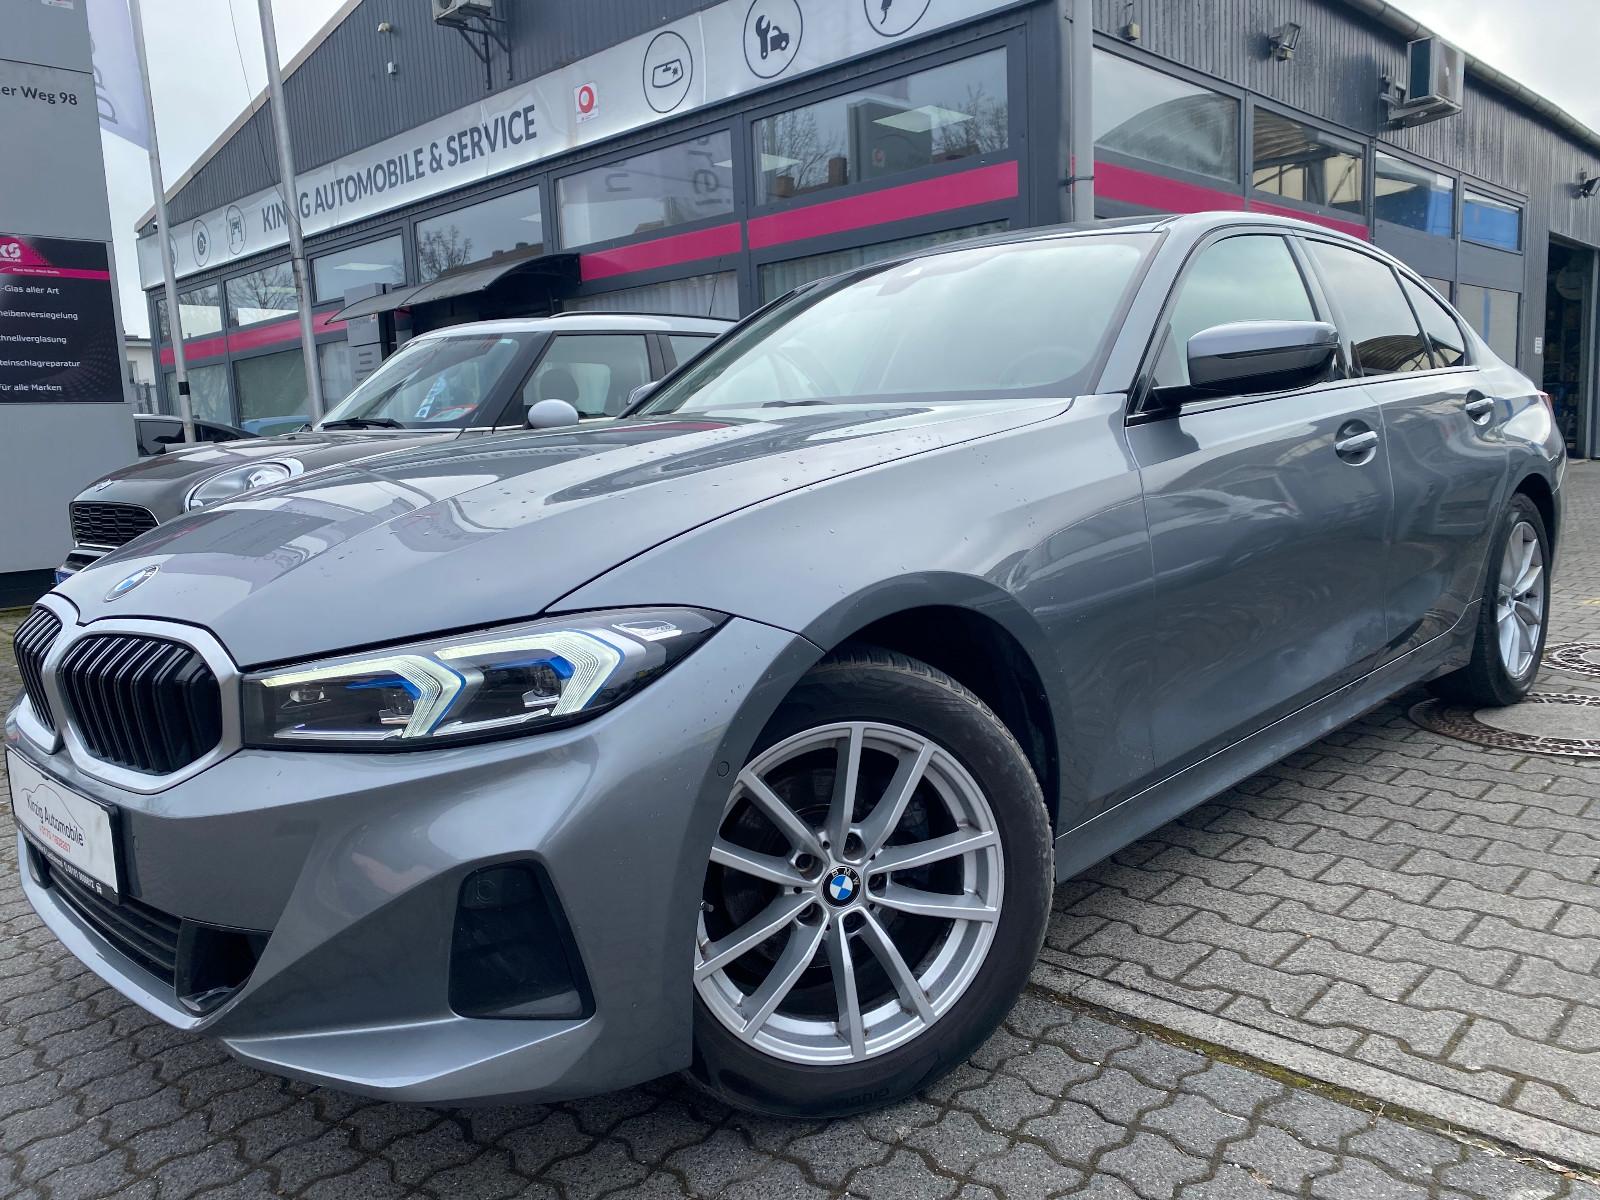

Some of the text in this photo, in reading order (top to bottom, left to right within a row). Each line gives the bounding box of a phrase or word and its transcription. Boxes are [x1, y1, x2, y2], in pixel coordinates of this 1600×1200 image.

[0, 86, 78, 105] er Weg 98
[262, 104, 538, 232] KING AUTOMOBILE & SERVICE
[0, 285, 60, 295] -Glas aller Art
[13, 383, 29, 391] alle
[44, 806, 84, 847] Automobile
[831, 867, 860, 886] BMW
